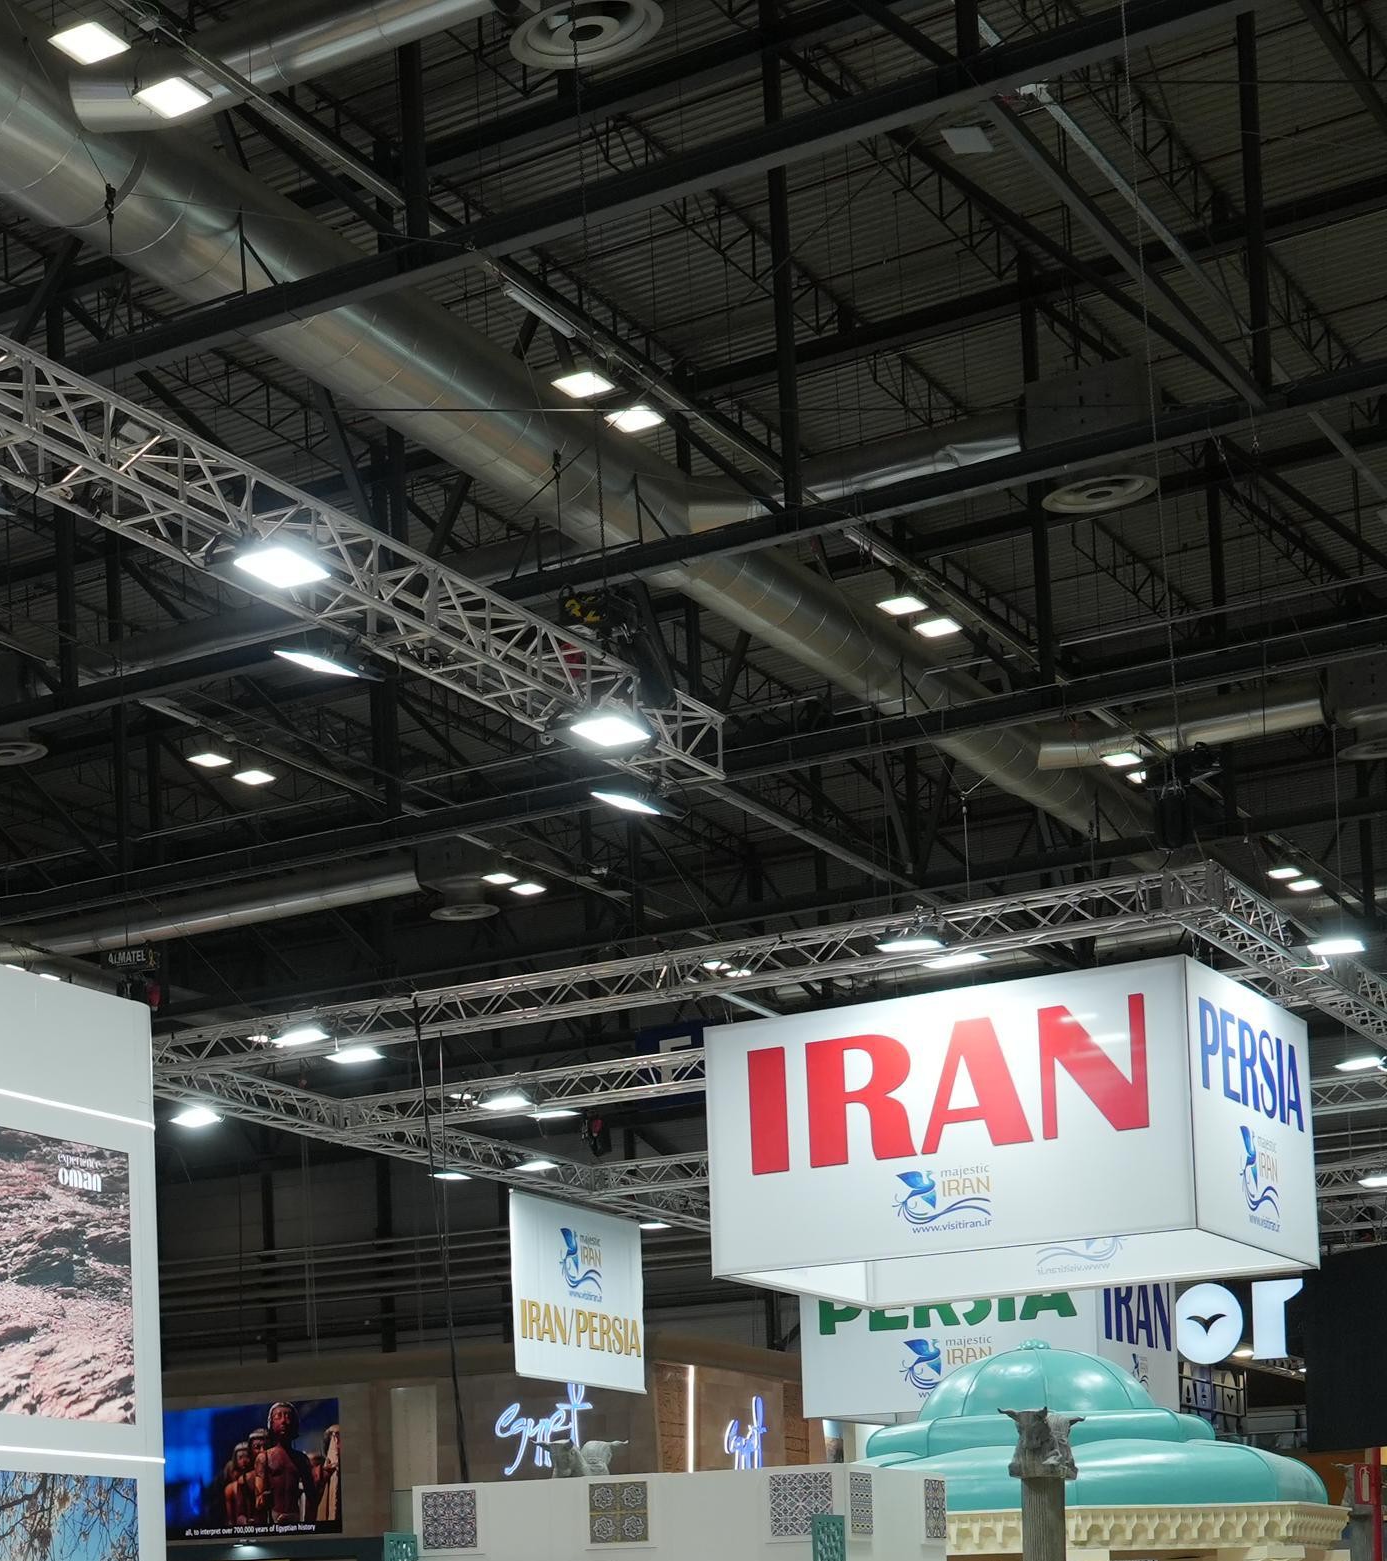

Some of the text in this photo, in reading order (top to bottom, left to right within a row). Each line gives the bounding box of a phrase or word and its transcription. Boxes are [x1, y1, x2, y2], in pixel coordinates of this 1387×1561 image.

[1199, 996, 1305, 1133] PERSIA
[747, 993, 1150, 1176] IRAN
[58, 1167, 102, 1192] oman
[940, 1164, 990, 1180] majestic
[1258, 1151, 1278, 1184] IRAN
[941, 1175, 991, 1198] IRAN
[911, 1217, 993, 1234] www.visitiran.ir
[580, 1245, 603, 1269] IRAN
[520, 1299, 642, 1358] IRAN/PERSIA
[1103, 1282, 1172, 1352] IRAN
[945, 1334, 993, 1349] majestic
[255, 1526, 269, 1534] years
[298, 1523, 316, 1532] history
